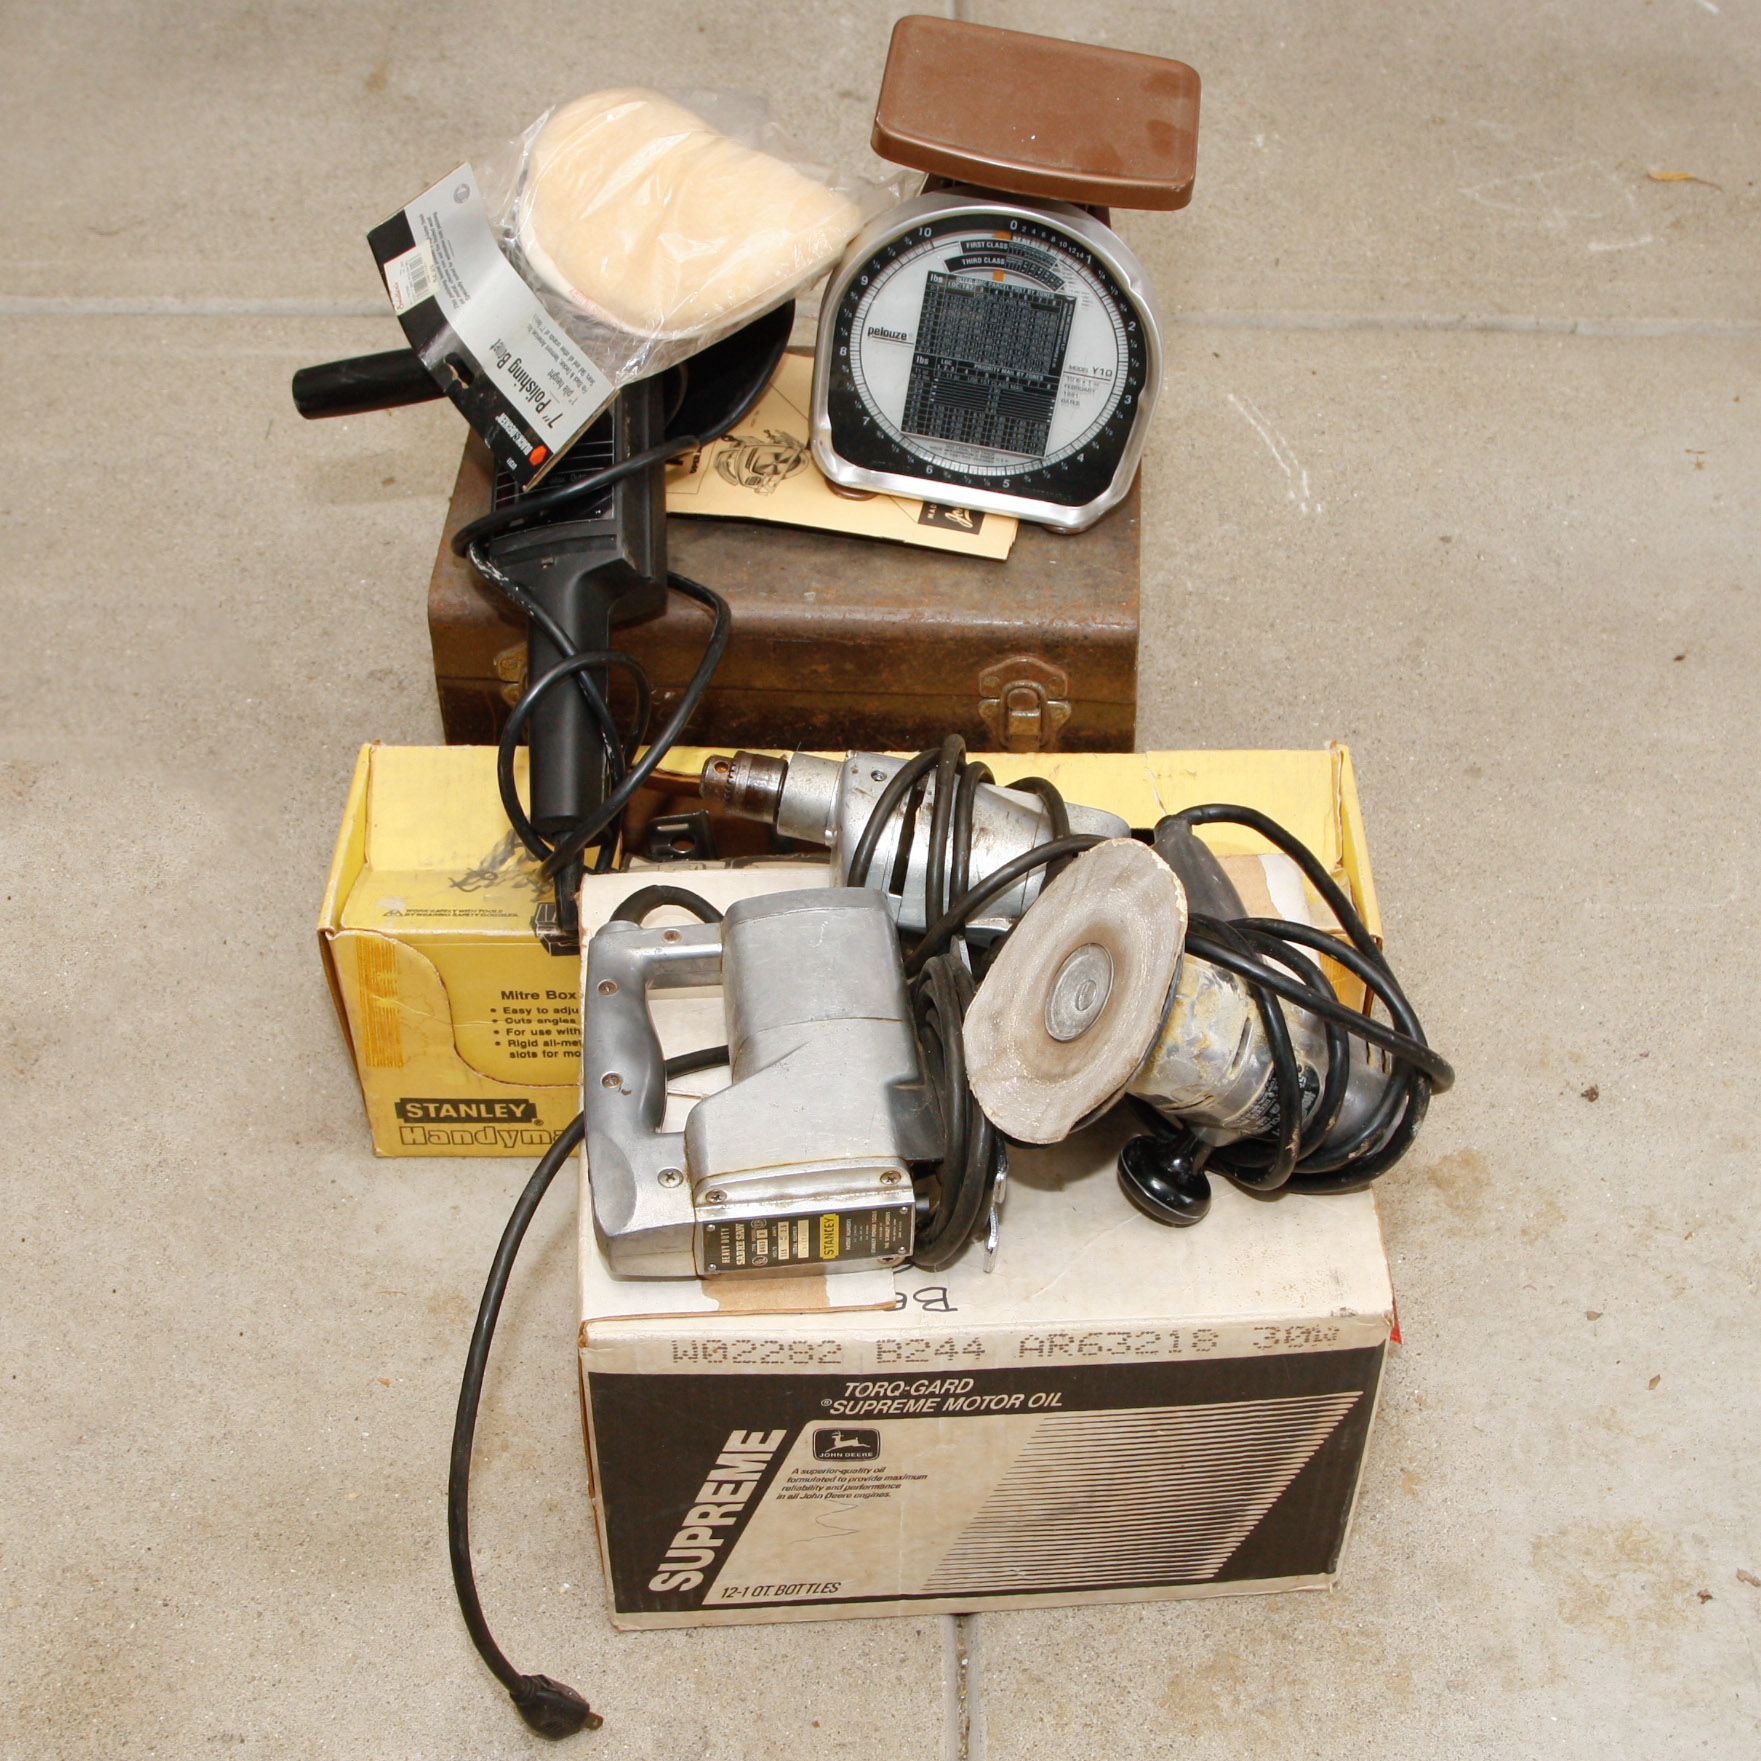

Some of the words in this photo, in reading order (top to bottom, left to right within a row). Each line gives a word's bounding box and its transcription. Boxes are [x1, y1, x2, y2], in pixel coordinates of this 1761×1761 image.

[1010, 220, 1017, 230] 0
[919, 227, 932, 237] 10
[986, 241, 1008, 250] CLASS
[962, 257, 982, 265] THIRD
[984, 256, 1005, 265] CLASS
[1086, 255, 1092, 264] 1
[861, 276, 868, 286] 9
[930, 273, 943, 282] lbs
[1128, 322, 1136, 331] 2
[868, 326, 907, 340] pelouze
[840, 347, 847, 356] 8
[916, 355, 929, 365] lbs
[1092, 367, 1112, 377] Y10
[508, 358, 551, 414] Polishing
[1064, 384, 1096, 393] FEBRUARY
[1124, 395, 1131, 404] 3
[863, 417, 870, 426] 7
[1077, 453, 1084, 462] 4
[926, 465, 933, 474] 6
[1003, 479, 1010, 488] 5
[501, 991, 539, 1000] Mitre
[545, 990, 577, 1000] Box
[503, 1007, 532, 1015] Easy
[553, 1007, 579, 1015] adju
[537, 1017, 576, 1025] angles
[508, 1040, 538, 1049] Rigid
[405, 1103, 527, 1118] STANLEY
[720, 1228, 729, 1244] DUTY
[735, 1224, 745, 1240] SAW
[824, 1217, 834, 1255] STANLEY
[721, 1246, 730, 1264] HEAVY
[736, 1241, 745, 1265] SABRE
[876, 1336, 986, 1363] B244
[1018, 1327, 1220, 1357] AR63218
[844, 1378, 974, 1398] TORQ-GARD
[830, 1397, 941, 1415] SUPREME
[942, 1394, 1025, 1412] MOTOR
[1027, 1392, 1063, 1407] OIL
[848, 1474, 883, 1483] provide
[843, 1483, 902, 1491] performance
[648, 1429, 787, 1592] SUPREME
[720, 1585, 750, 1599] 12-1
[774, 1581, 842, 1595] BOTTLES
